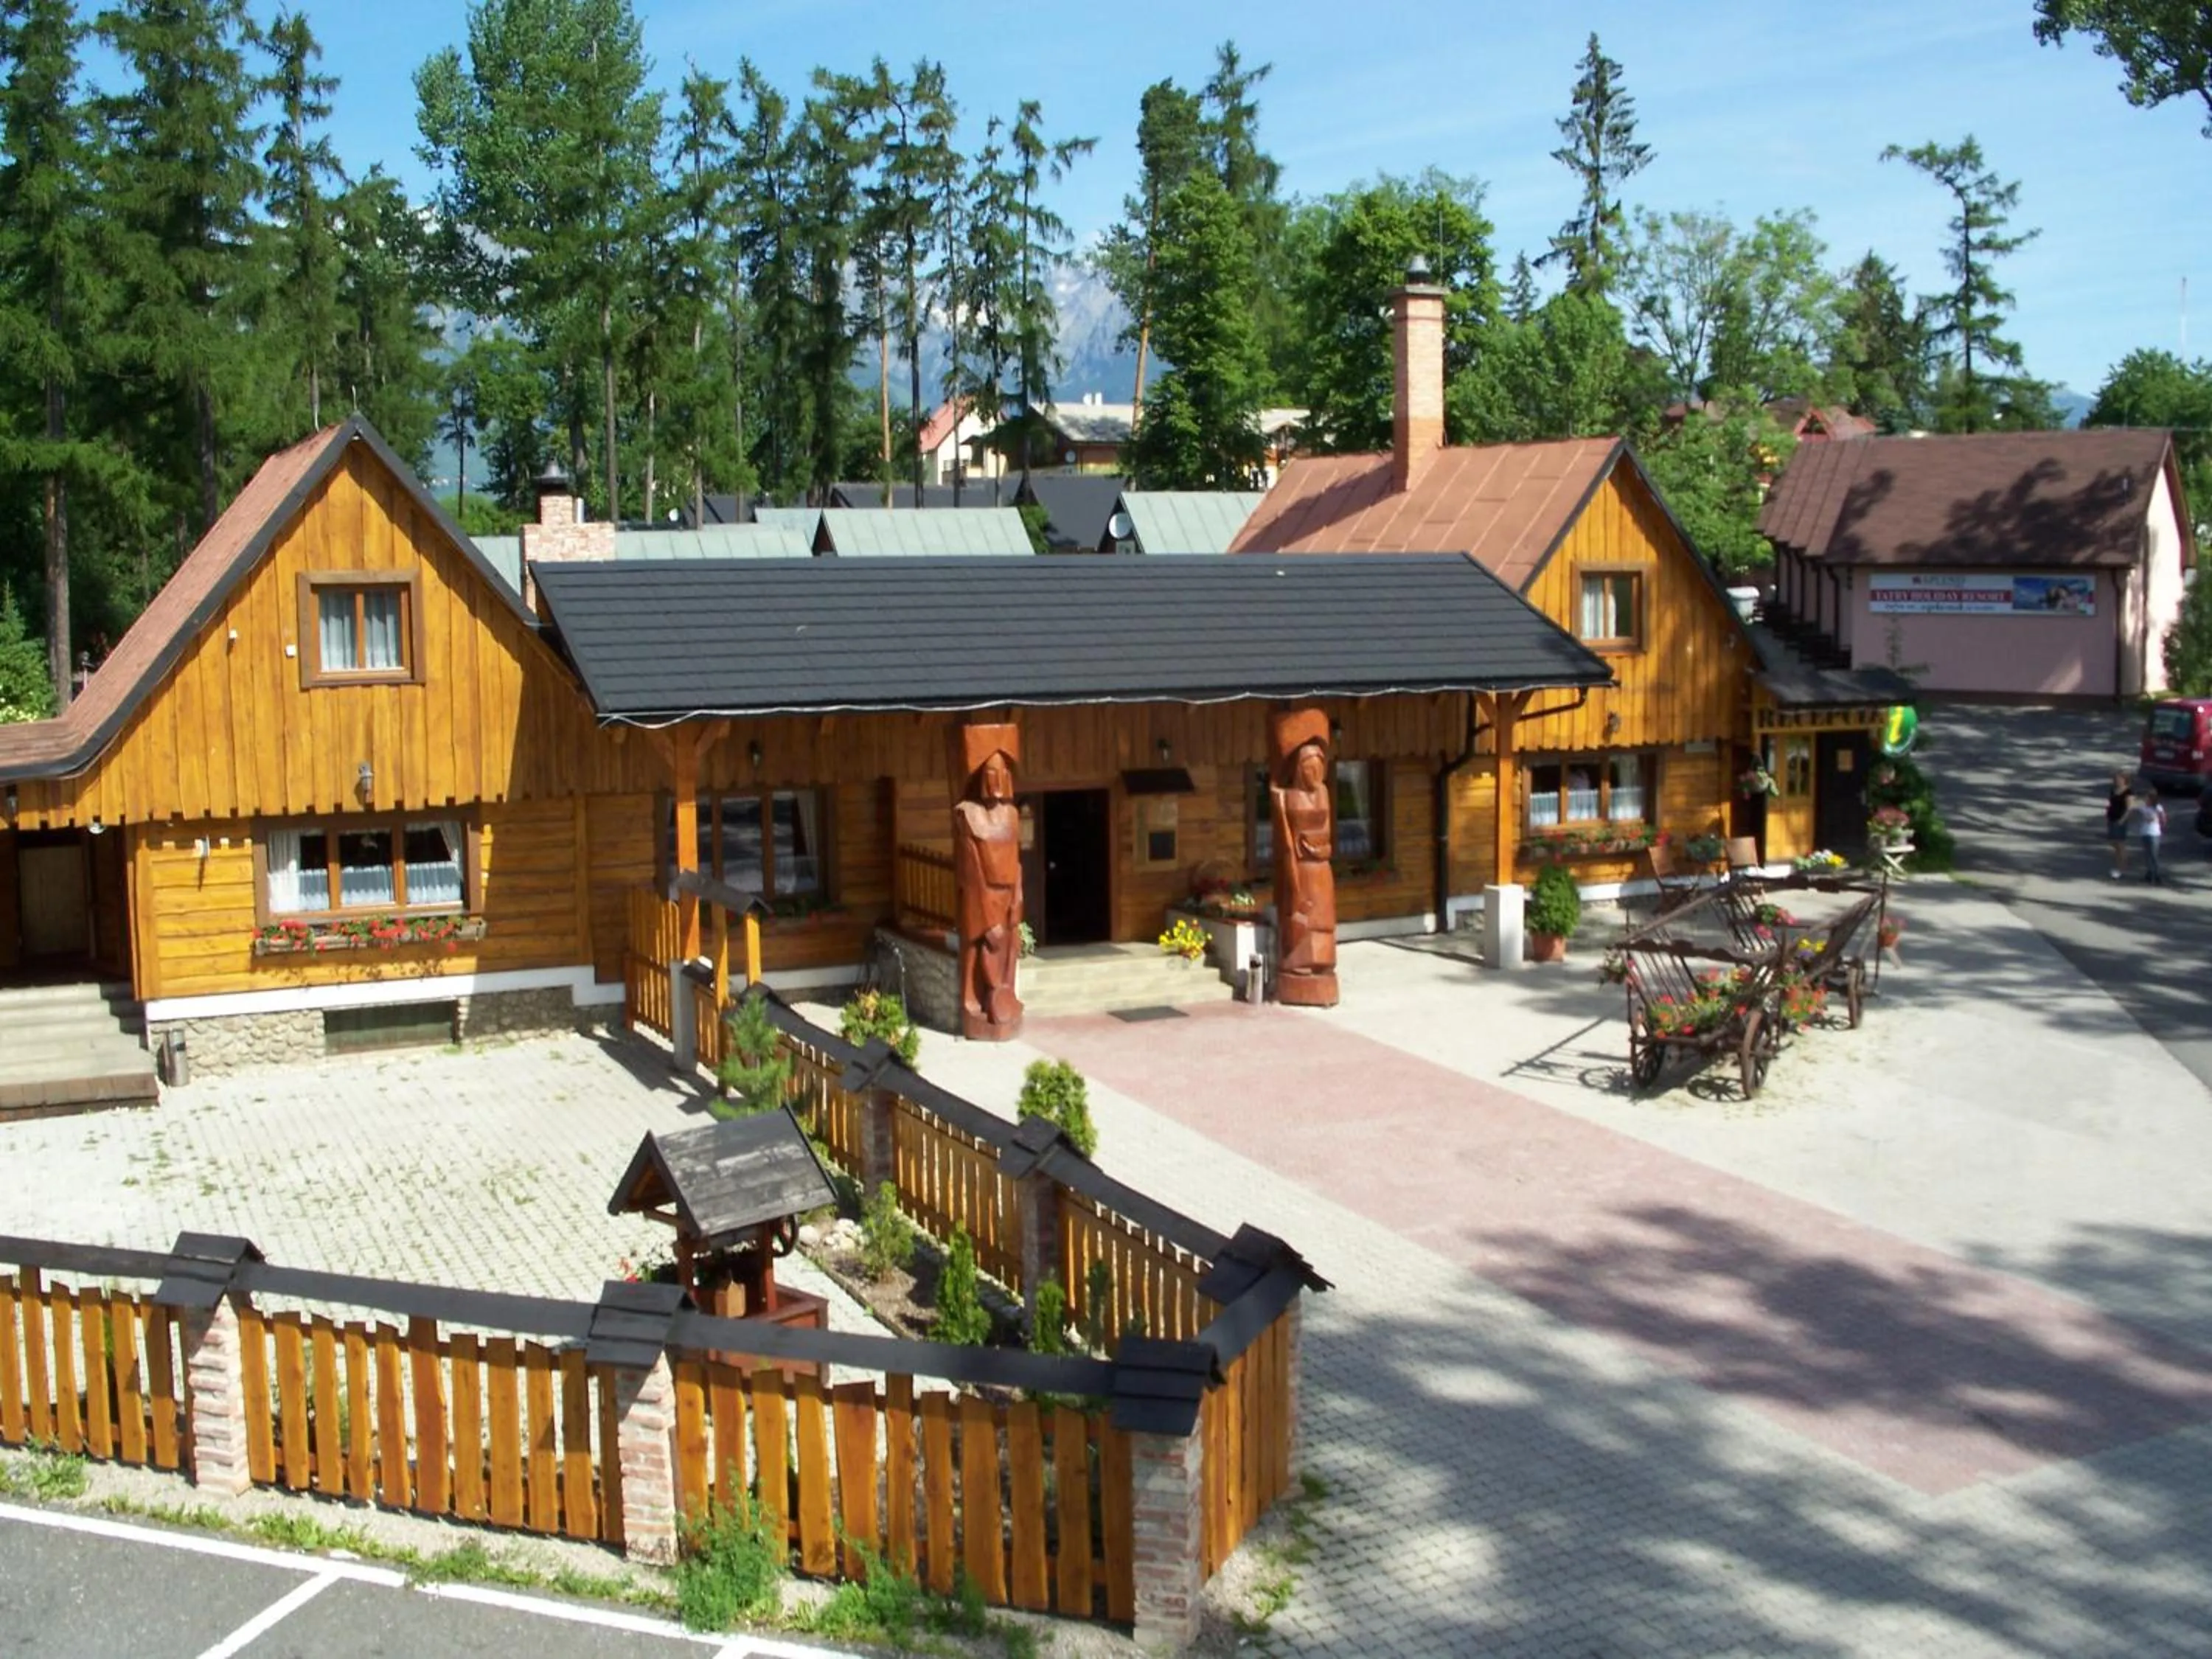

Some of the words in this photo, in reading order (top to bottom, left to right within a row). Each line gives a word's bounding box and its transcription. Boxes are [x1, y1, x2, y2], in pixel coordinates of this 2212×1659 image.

[1875, 591, 1910, 601] TATRY
[1911, 591, 1958, 601] HOLIDAY
[1961, 591, 2005, 602] RESORT
